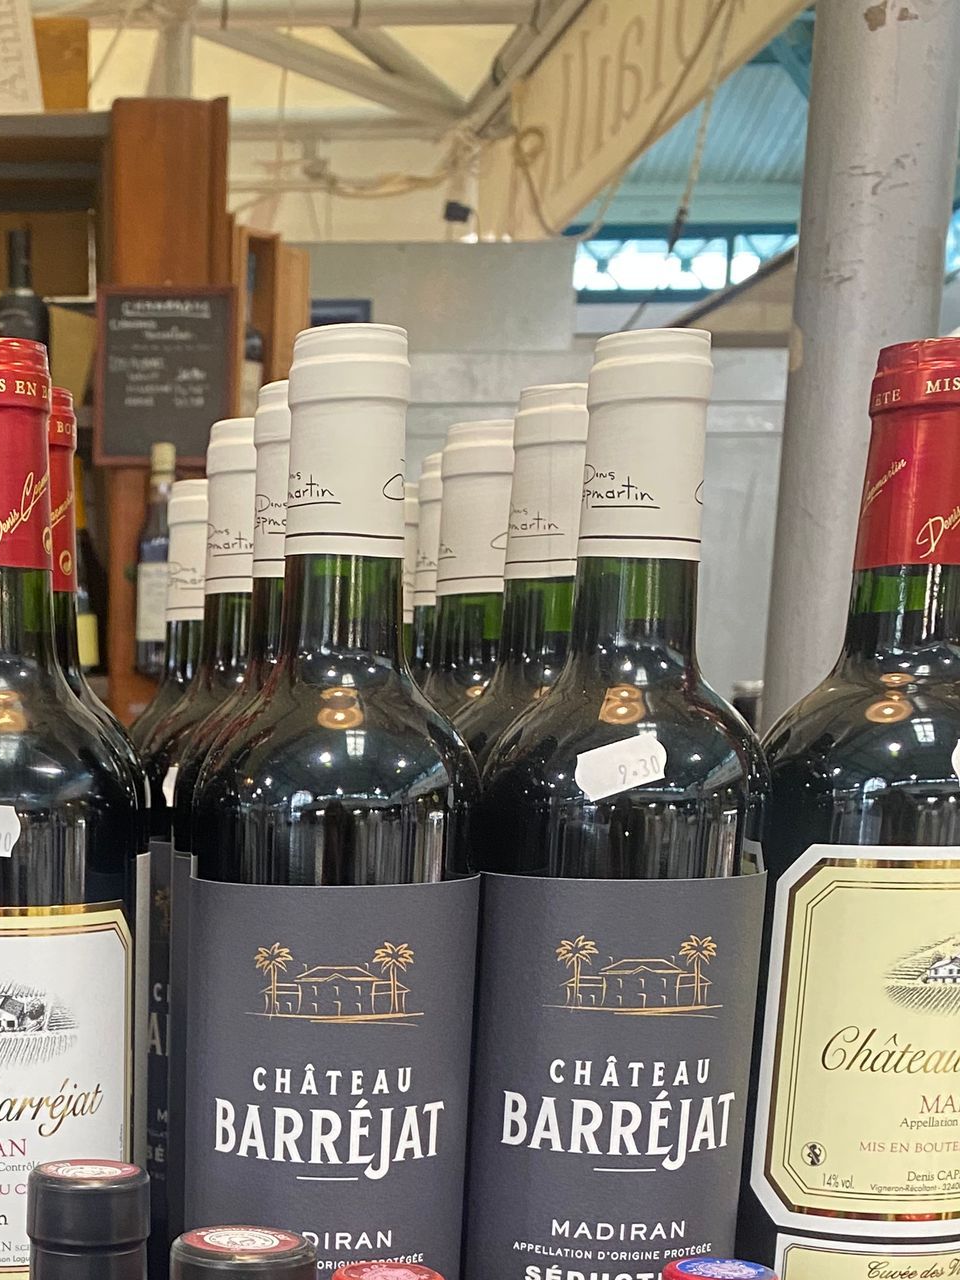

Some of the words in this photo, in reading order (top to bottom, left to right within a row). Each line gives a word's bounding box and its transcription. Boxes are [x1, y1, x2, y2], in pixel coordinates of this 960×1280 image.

[15, 380, 37, 396] EN
[252, 1063, 412, 1096] CHÂTEAU
[549, 1055, 710, 1088] CHÂTEAU
[500, 1090, 736, 1171] BARRÉJAT
[899, 1117, 958, 1130] Appellation
[214, 1098, 446, 1180] BARRÉJAT
[859, 1140, 886, 1153] MIS
[890, 1141, 910, 1153] EN
[907, 1170, 935, 1182] Denis
[550, 1219, 686, 1241] MADIRAN
[512, 1241, 592, 1260] APPELLATION
[597, 1249, 660, 1261] D'ORIGINE
[663, 1242, 712, 1259] PROTÉGÉE
[867, 1260, 918, 1280] Cuvée
[920, 1262, 945, 1279] des
